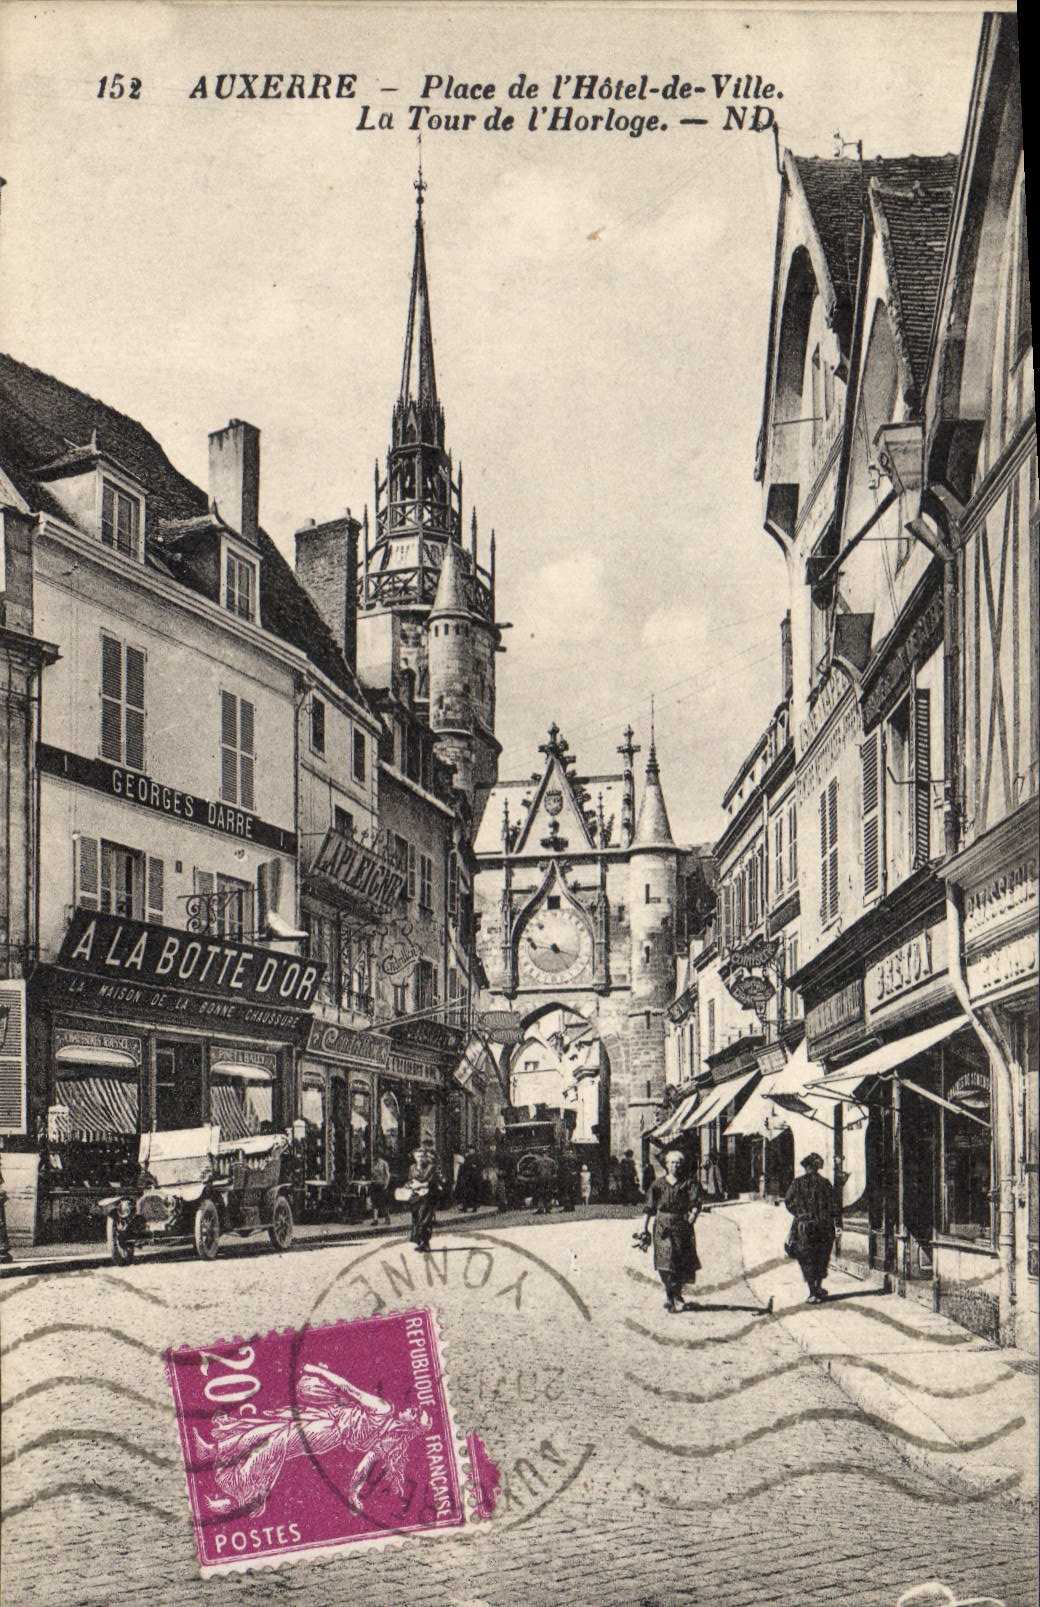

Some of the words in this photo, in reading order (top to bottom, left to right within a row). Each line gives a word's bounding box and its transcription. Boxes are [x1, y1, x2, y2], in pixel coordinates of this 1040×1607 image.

[111, 769, 195, 818] GEORGES
[207, 801, 254, 839] DARRE
[71, 920, 97, 961] A
[105, 926, 149, 971] LA
[155, 936, 254, 989] BOTTE
[255, 957, 317, 1000] D'OR
[69, 979, 84, 992] LA
[100, 983, 143, 1003] MAISON
[151, 993, 166, 1007] DE
[175, 998, 189, 1011] LA
[199, 1001, 237, 1018] BONNE
[244, 1006, 300, 1029] CHAUSSURE
[350, 1244, 529, 1313] YONNE
[404, 1316, 436, 1407] REPUBLIQUE
[213, 1522, 302, 1553] POSTES
